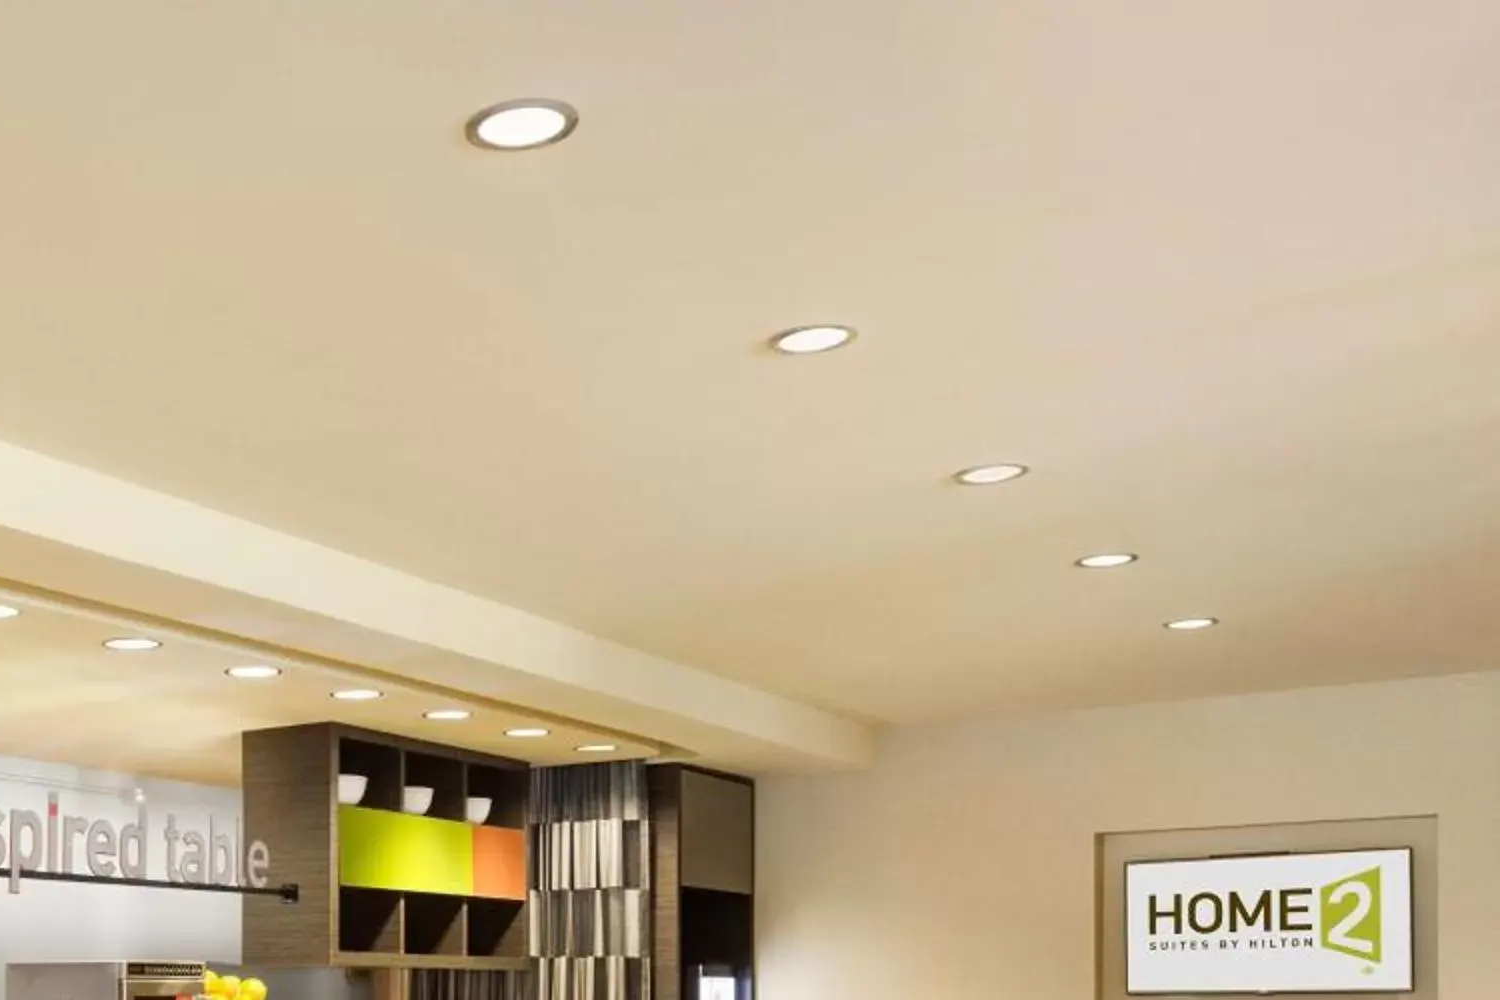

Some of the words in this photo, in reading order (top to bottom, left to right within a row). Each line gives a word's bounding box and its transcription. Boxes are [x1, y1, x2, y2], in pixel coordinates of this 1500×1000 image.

[164, 813, 270, 888] table
[1147, 887, 1313, 935] HOME
[1326, 878, 1377, 955] 2
[1148, 939, 1210, 952] SUITES
[1218, 937, 1239, 950] BY
[1249, 936, 1315, 950] HILTON
